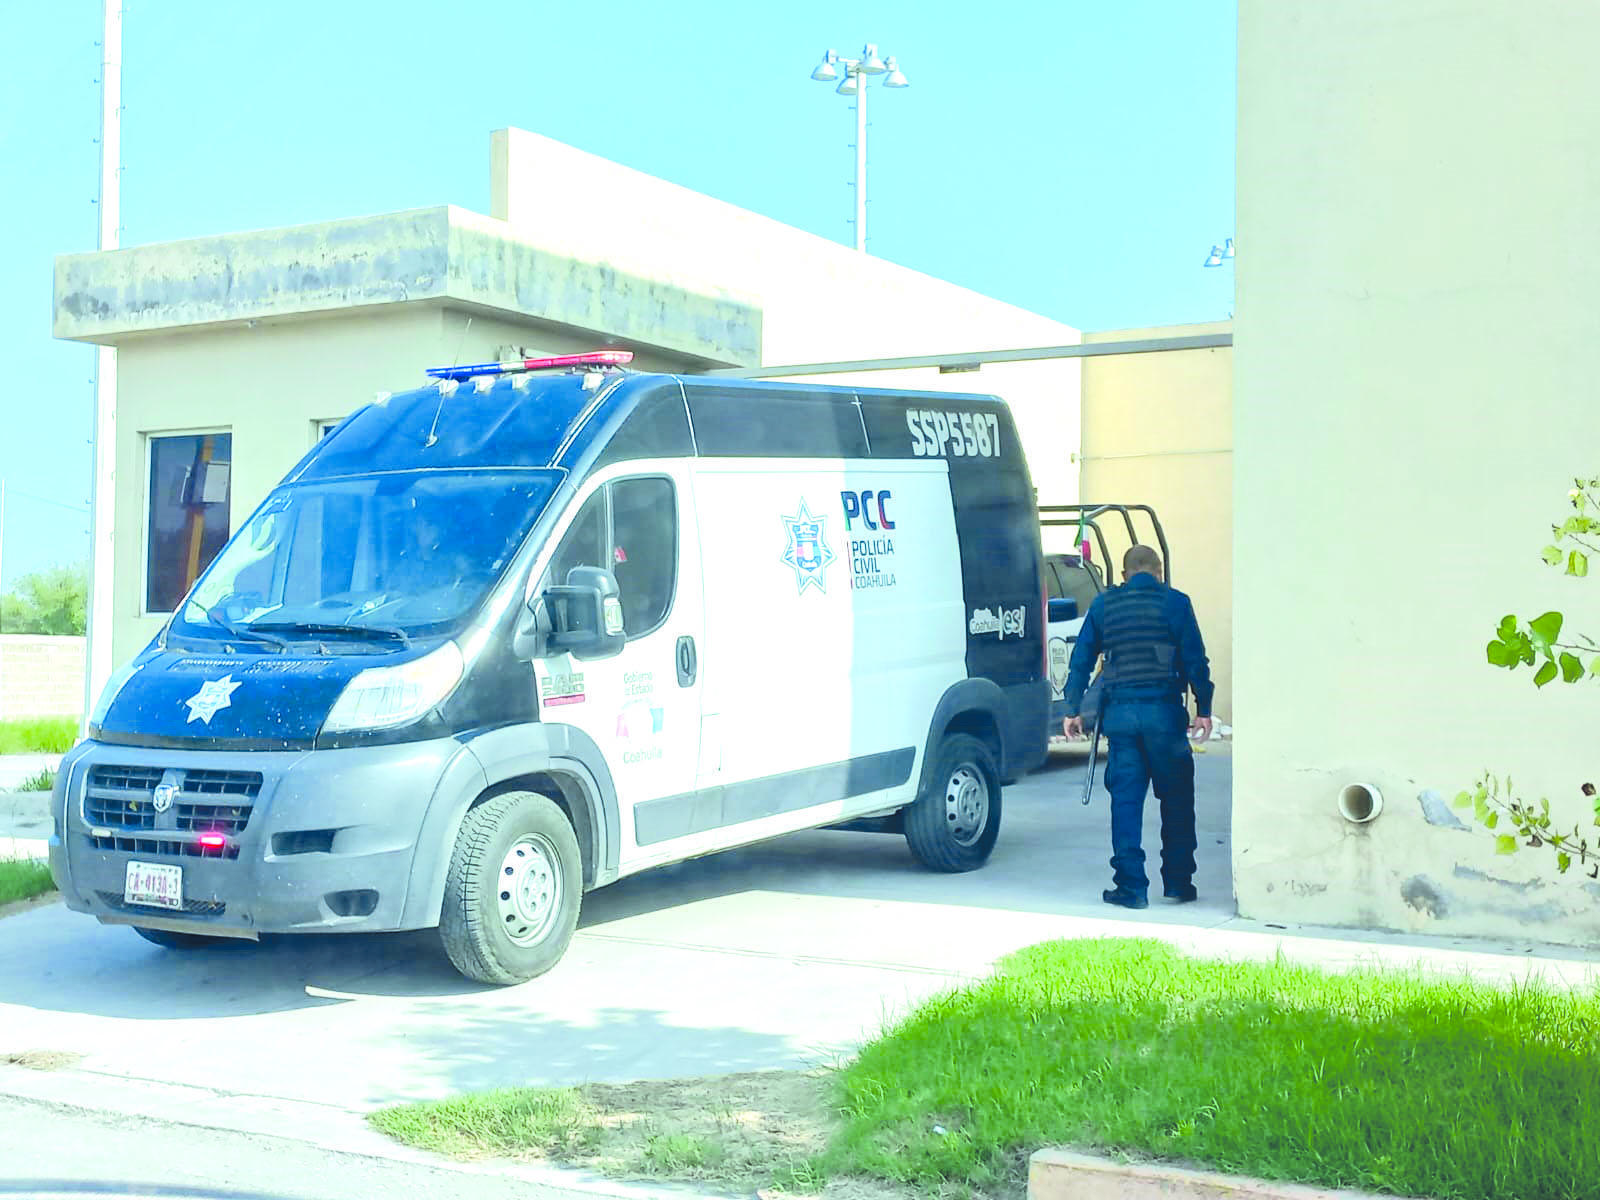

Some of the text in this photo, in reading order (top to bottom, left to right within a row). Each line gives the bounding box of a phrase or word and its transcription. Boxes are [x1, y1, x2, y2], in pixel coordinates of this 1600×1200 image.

[906, 409, 1000, 457] SSP5587
[840, 490, 896, 531] PCC
[851, 534, 895, 557] POLICÍA
[853, 558, 881, 574] CIVIL
[855, 574, 896, 589] COAHUILA
